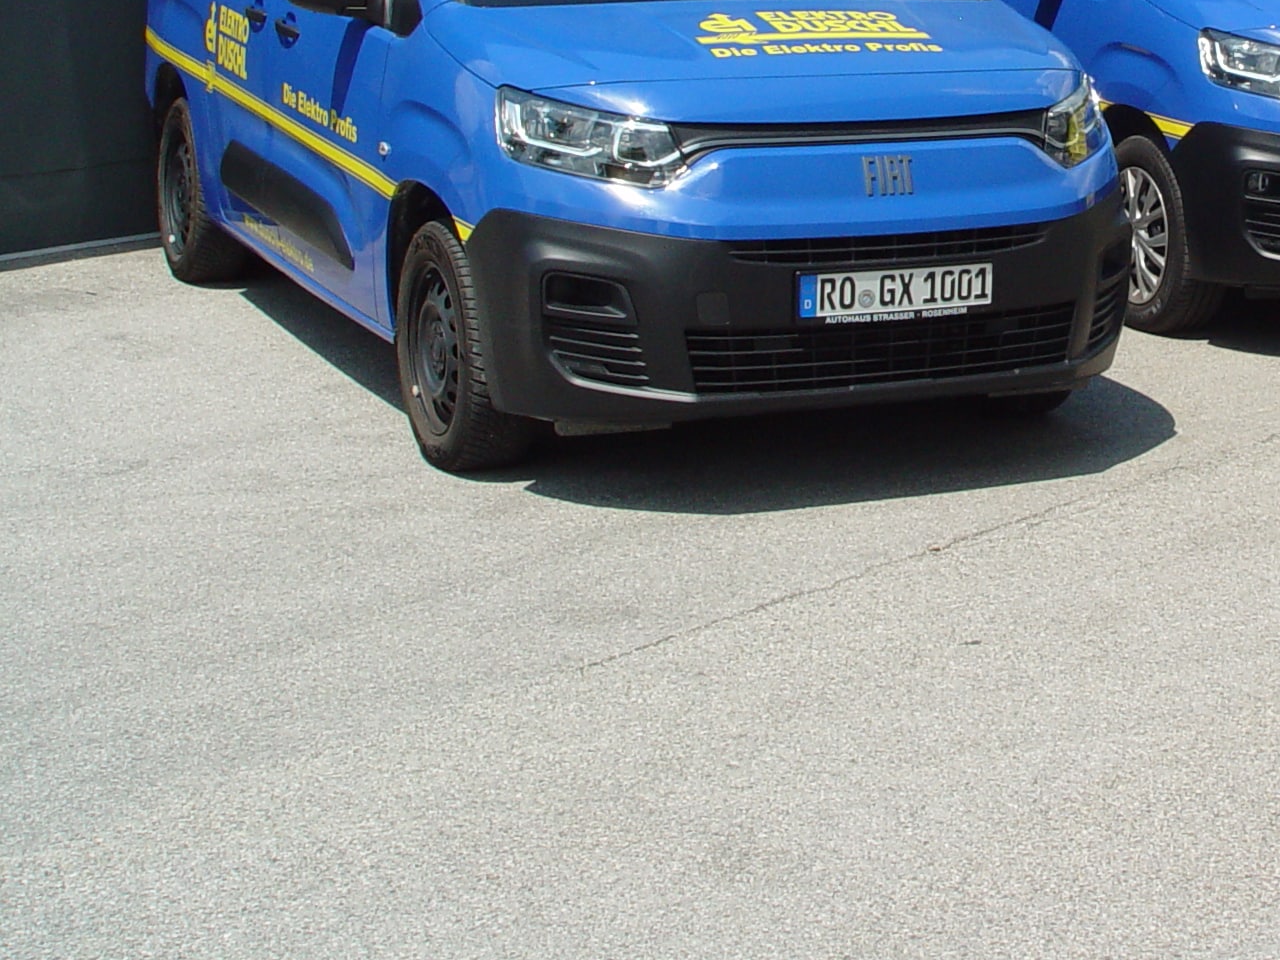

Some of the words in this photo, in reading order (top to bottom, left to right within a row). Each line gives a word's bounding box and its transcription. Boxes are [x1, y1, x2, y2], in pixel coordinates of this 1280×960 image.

[219, 4, 249, 44] ELEKTRO
[755, 11, 898, 22] ELEKTRO
[768, 20, 918, 33] DUSCHL
[217, 34, 248, 80] DUSCHL
[710, 46, 758, 58] Die
[763, 42, 861, 55] Elektro
[865, 41, 943, 53] Profis
[282, 82, 297, 108] Die
[298, 90, 328, 127] Elektro
[330, 109, 358, 143] Profis
[862, 154, 915, 197] FIAT
[804, 299, 812, 310] D
[819, 276, 856, 311] RO
[879, 272, 914, 307] GX
[923, 267, 989, 304] 1001
[825, 314, 871, 324] AUTOHAUS
[872, 312, 915, 323] STRASSER
[922, 306, 968, 318] ROSENHEIM
